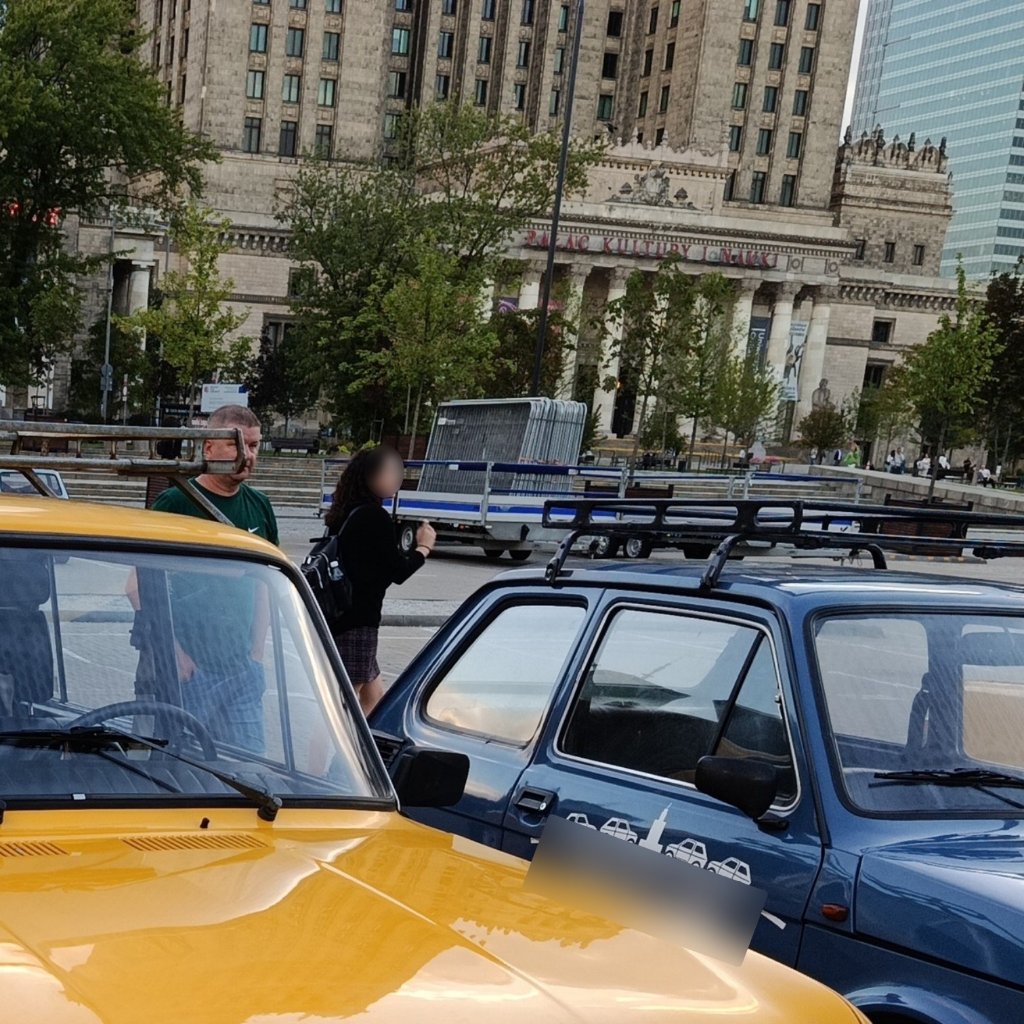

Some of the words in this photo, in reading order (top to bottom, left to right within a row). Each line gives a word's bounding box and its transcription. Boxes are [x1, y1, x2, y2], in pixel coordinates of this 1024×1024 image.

[527, 230, 590, 252] PAAC
[603, 237, 692, 259] KULTURY
[703, 246, 708, 263] I
[720, 248, 779, 267] NAUKI
